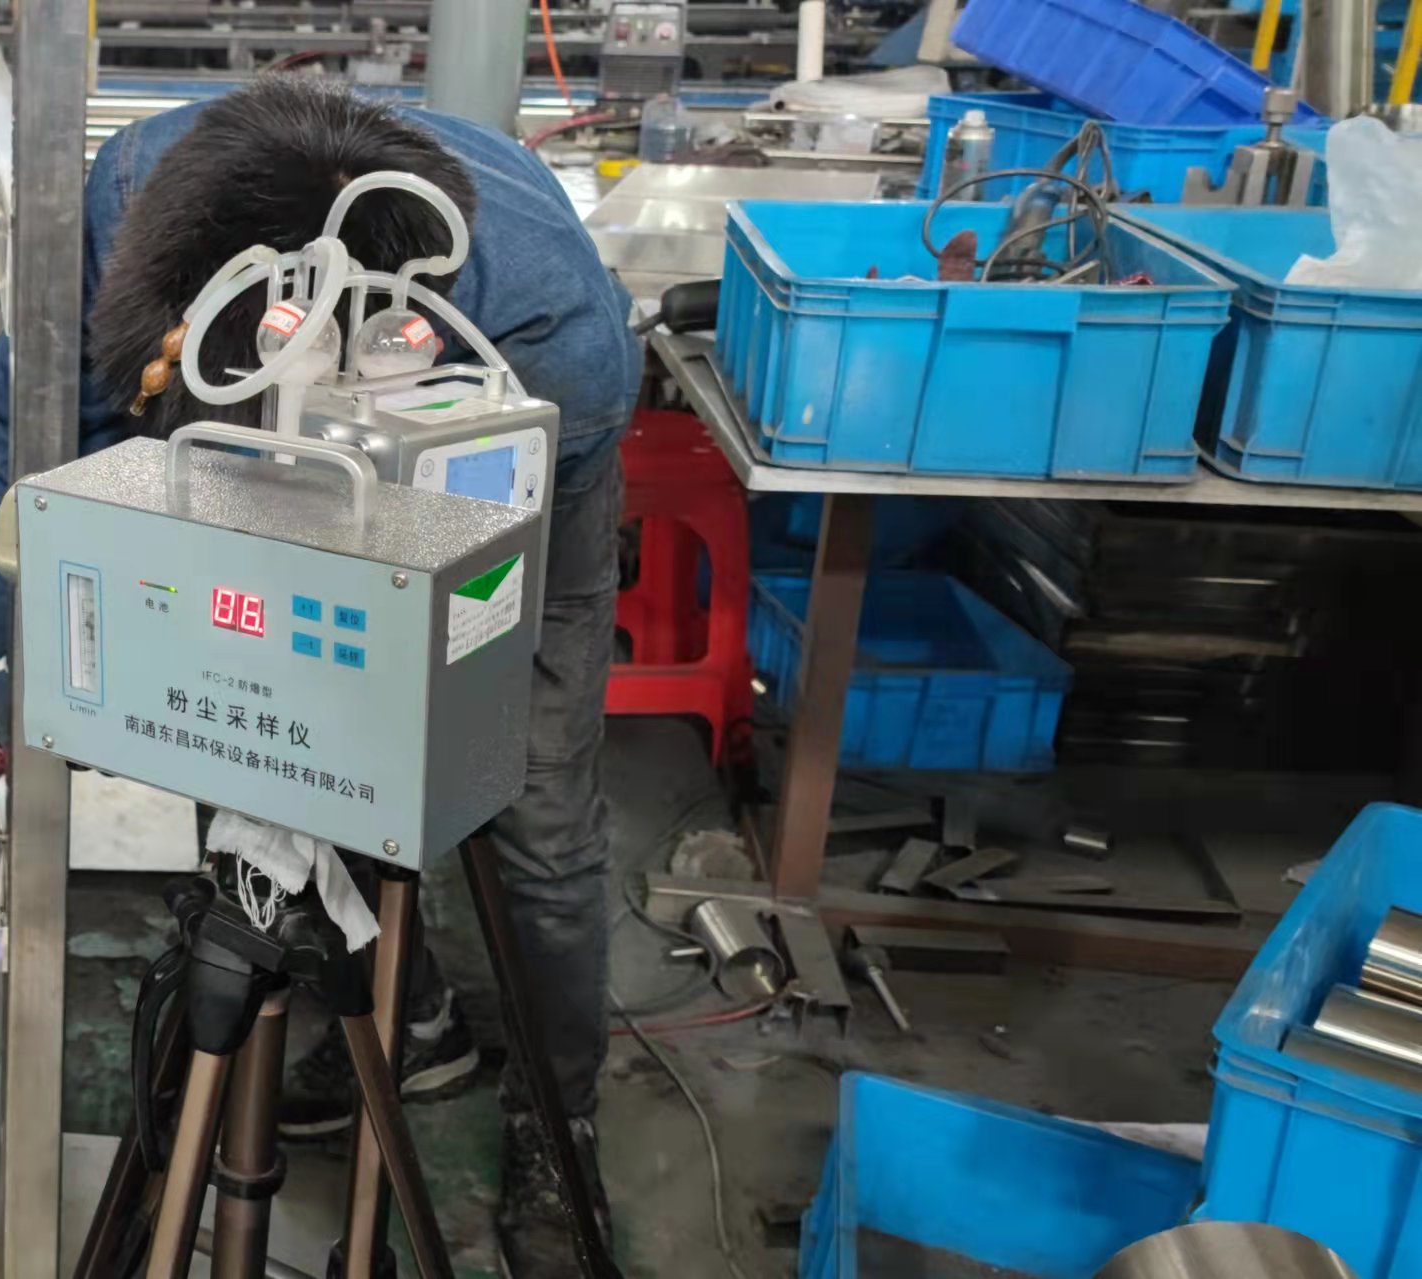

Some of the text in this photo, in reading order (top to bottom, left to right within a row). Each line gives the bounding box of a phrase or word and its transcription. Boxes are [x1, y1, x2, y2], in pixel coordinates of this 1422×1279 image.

[145, 597, 170, 613] 电池
[339, 609, 360, 625] 复位
[69, 701, 97, 717] L/min
[166, 686, 311, 750] 粉尘采样仪
[124, 714, 376, 804] 南通东昌环保设备科技有限公司
